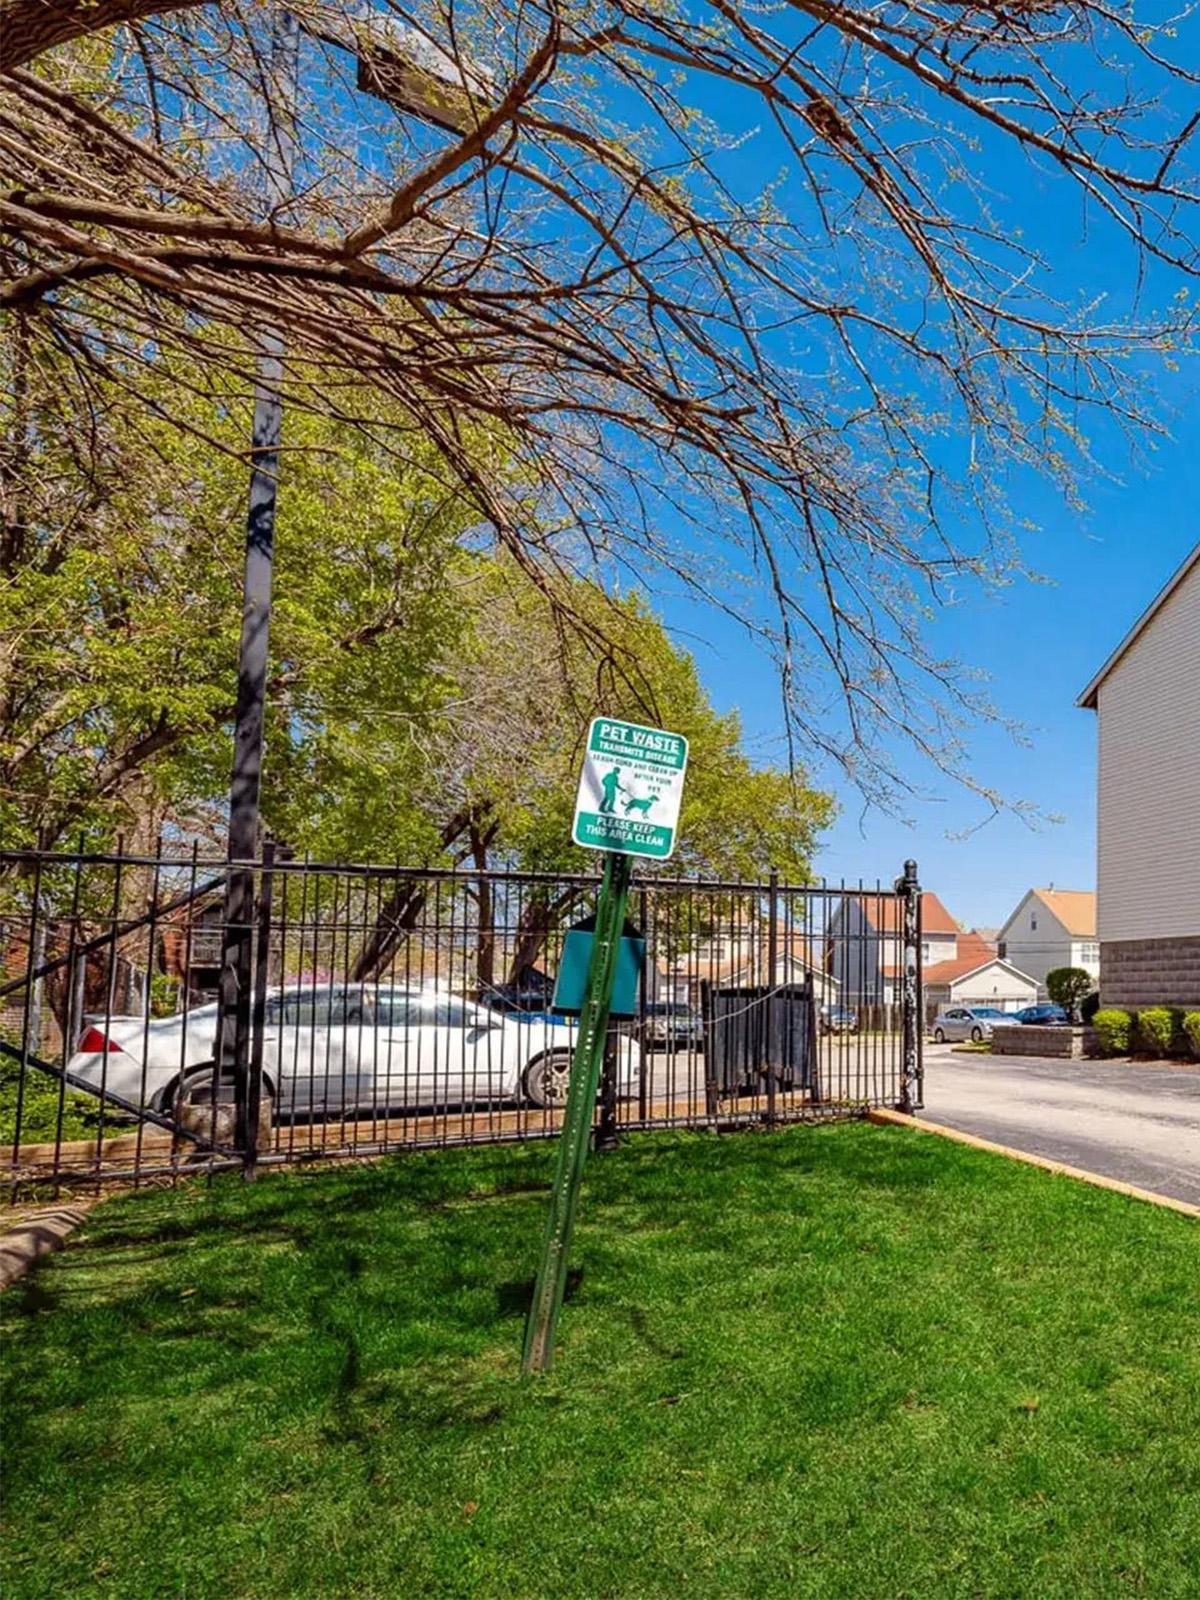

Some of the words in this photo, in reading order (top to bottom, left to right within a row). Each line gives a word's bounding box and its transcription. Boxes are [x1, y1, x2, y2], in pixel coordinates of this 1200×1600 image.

[600, 724, 629, 742] PET
[633, 731, 680, 751] WASTE
[586, 824, 607, 837] THIS
[608, 829, 633, 841] AREA
[635, 834, 664, 847] CLEAN
[596, 817, 632, 831] PLEASE
[633, 823, 656, 834] KEEP
